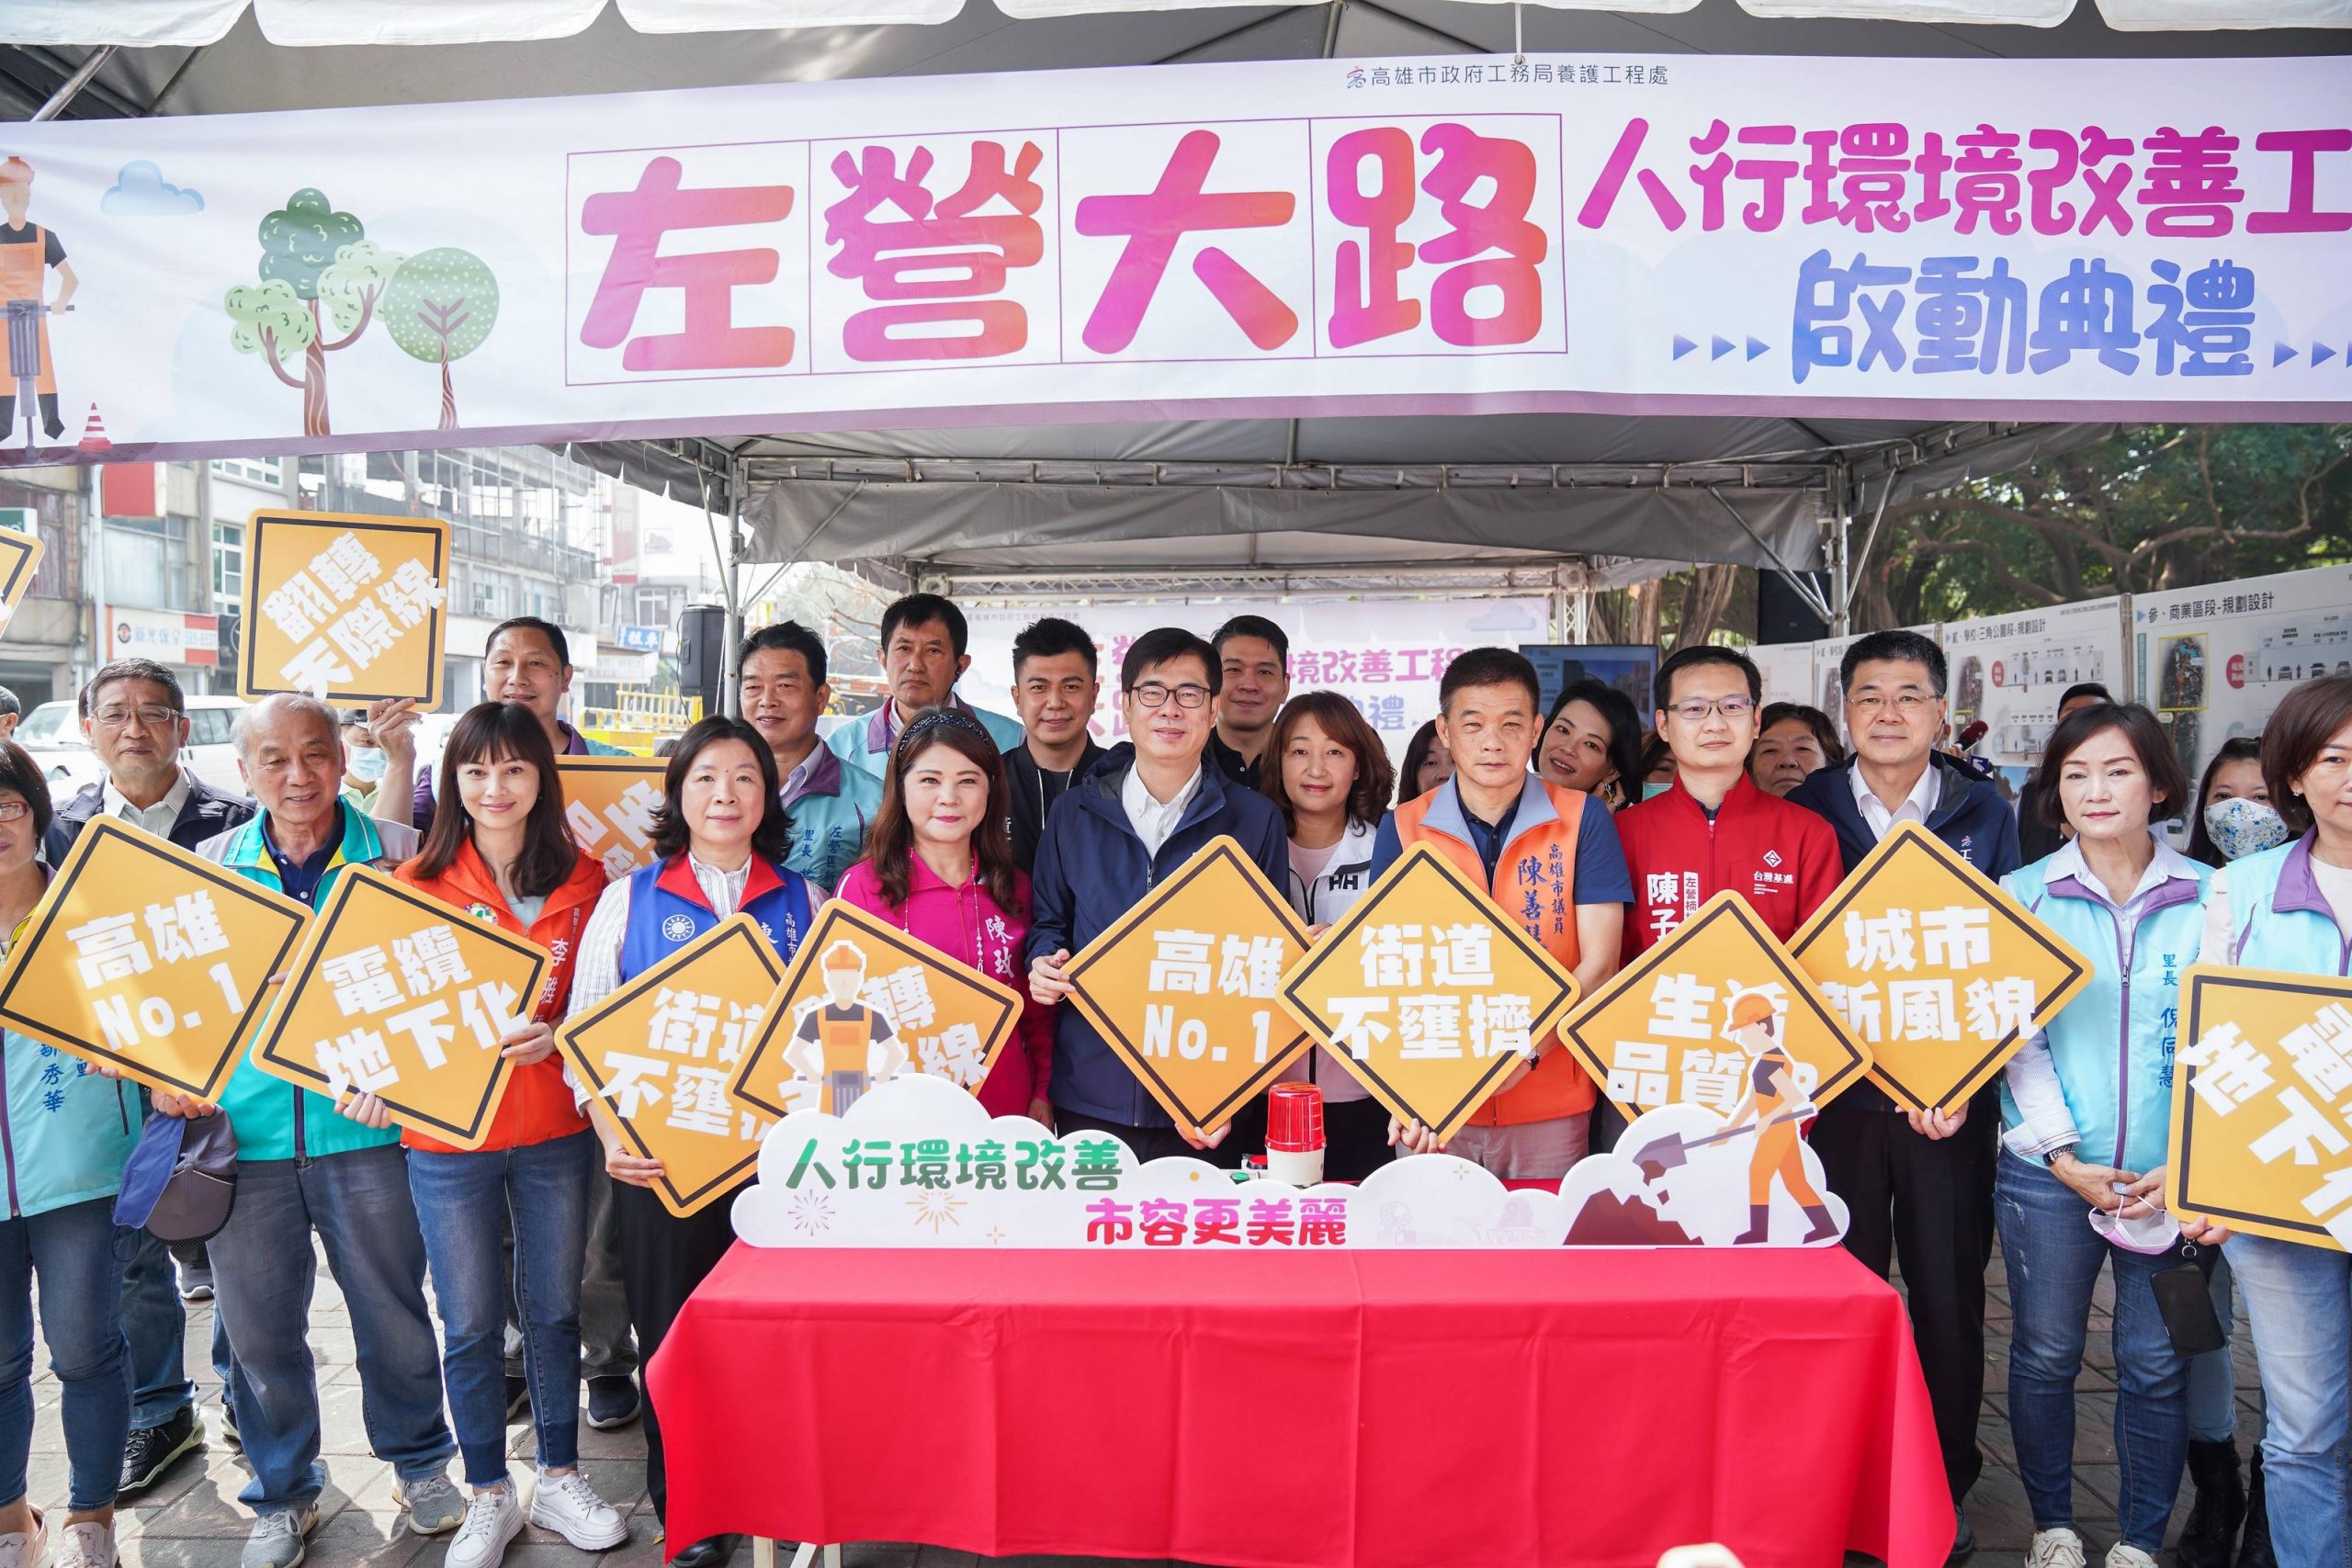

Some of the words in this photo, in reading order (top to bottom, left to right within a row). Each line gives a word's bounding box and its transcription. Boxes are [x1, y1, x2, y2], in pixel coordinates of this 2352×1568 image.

[1371, 63, 1668, 85] 高雄市政府工務局養護工程處
[1577, 117, 2352, 238] 人行環境改善工
[580, 122, 1547, 372] 左營大路
[1549, 843, 1566, 935] 高雄市議員
[66, 889, 230, 989] 高雄
[785, 911, 798, 962] 高雄市
[985, 915, 1014, 987] 陳玫
[1148, 928, 1284, 999] 高雄
[1360, 923, 1495, 988] 街道
[1844, 906, 1991, 973] 城市
[2163, 953, 2179, 986] 里長
[313, 981, 530, 1100] 地下化
[1327, 994, 1532, 1060] 不壅擠
[786, 1137, 1123, 1191] 人行環境改善
[1086, 1197, 1347, 1247] 市容更美麗
